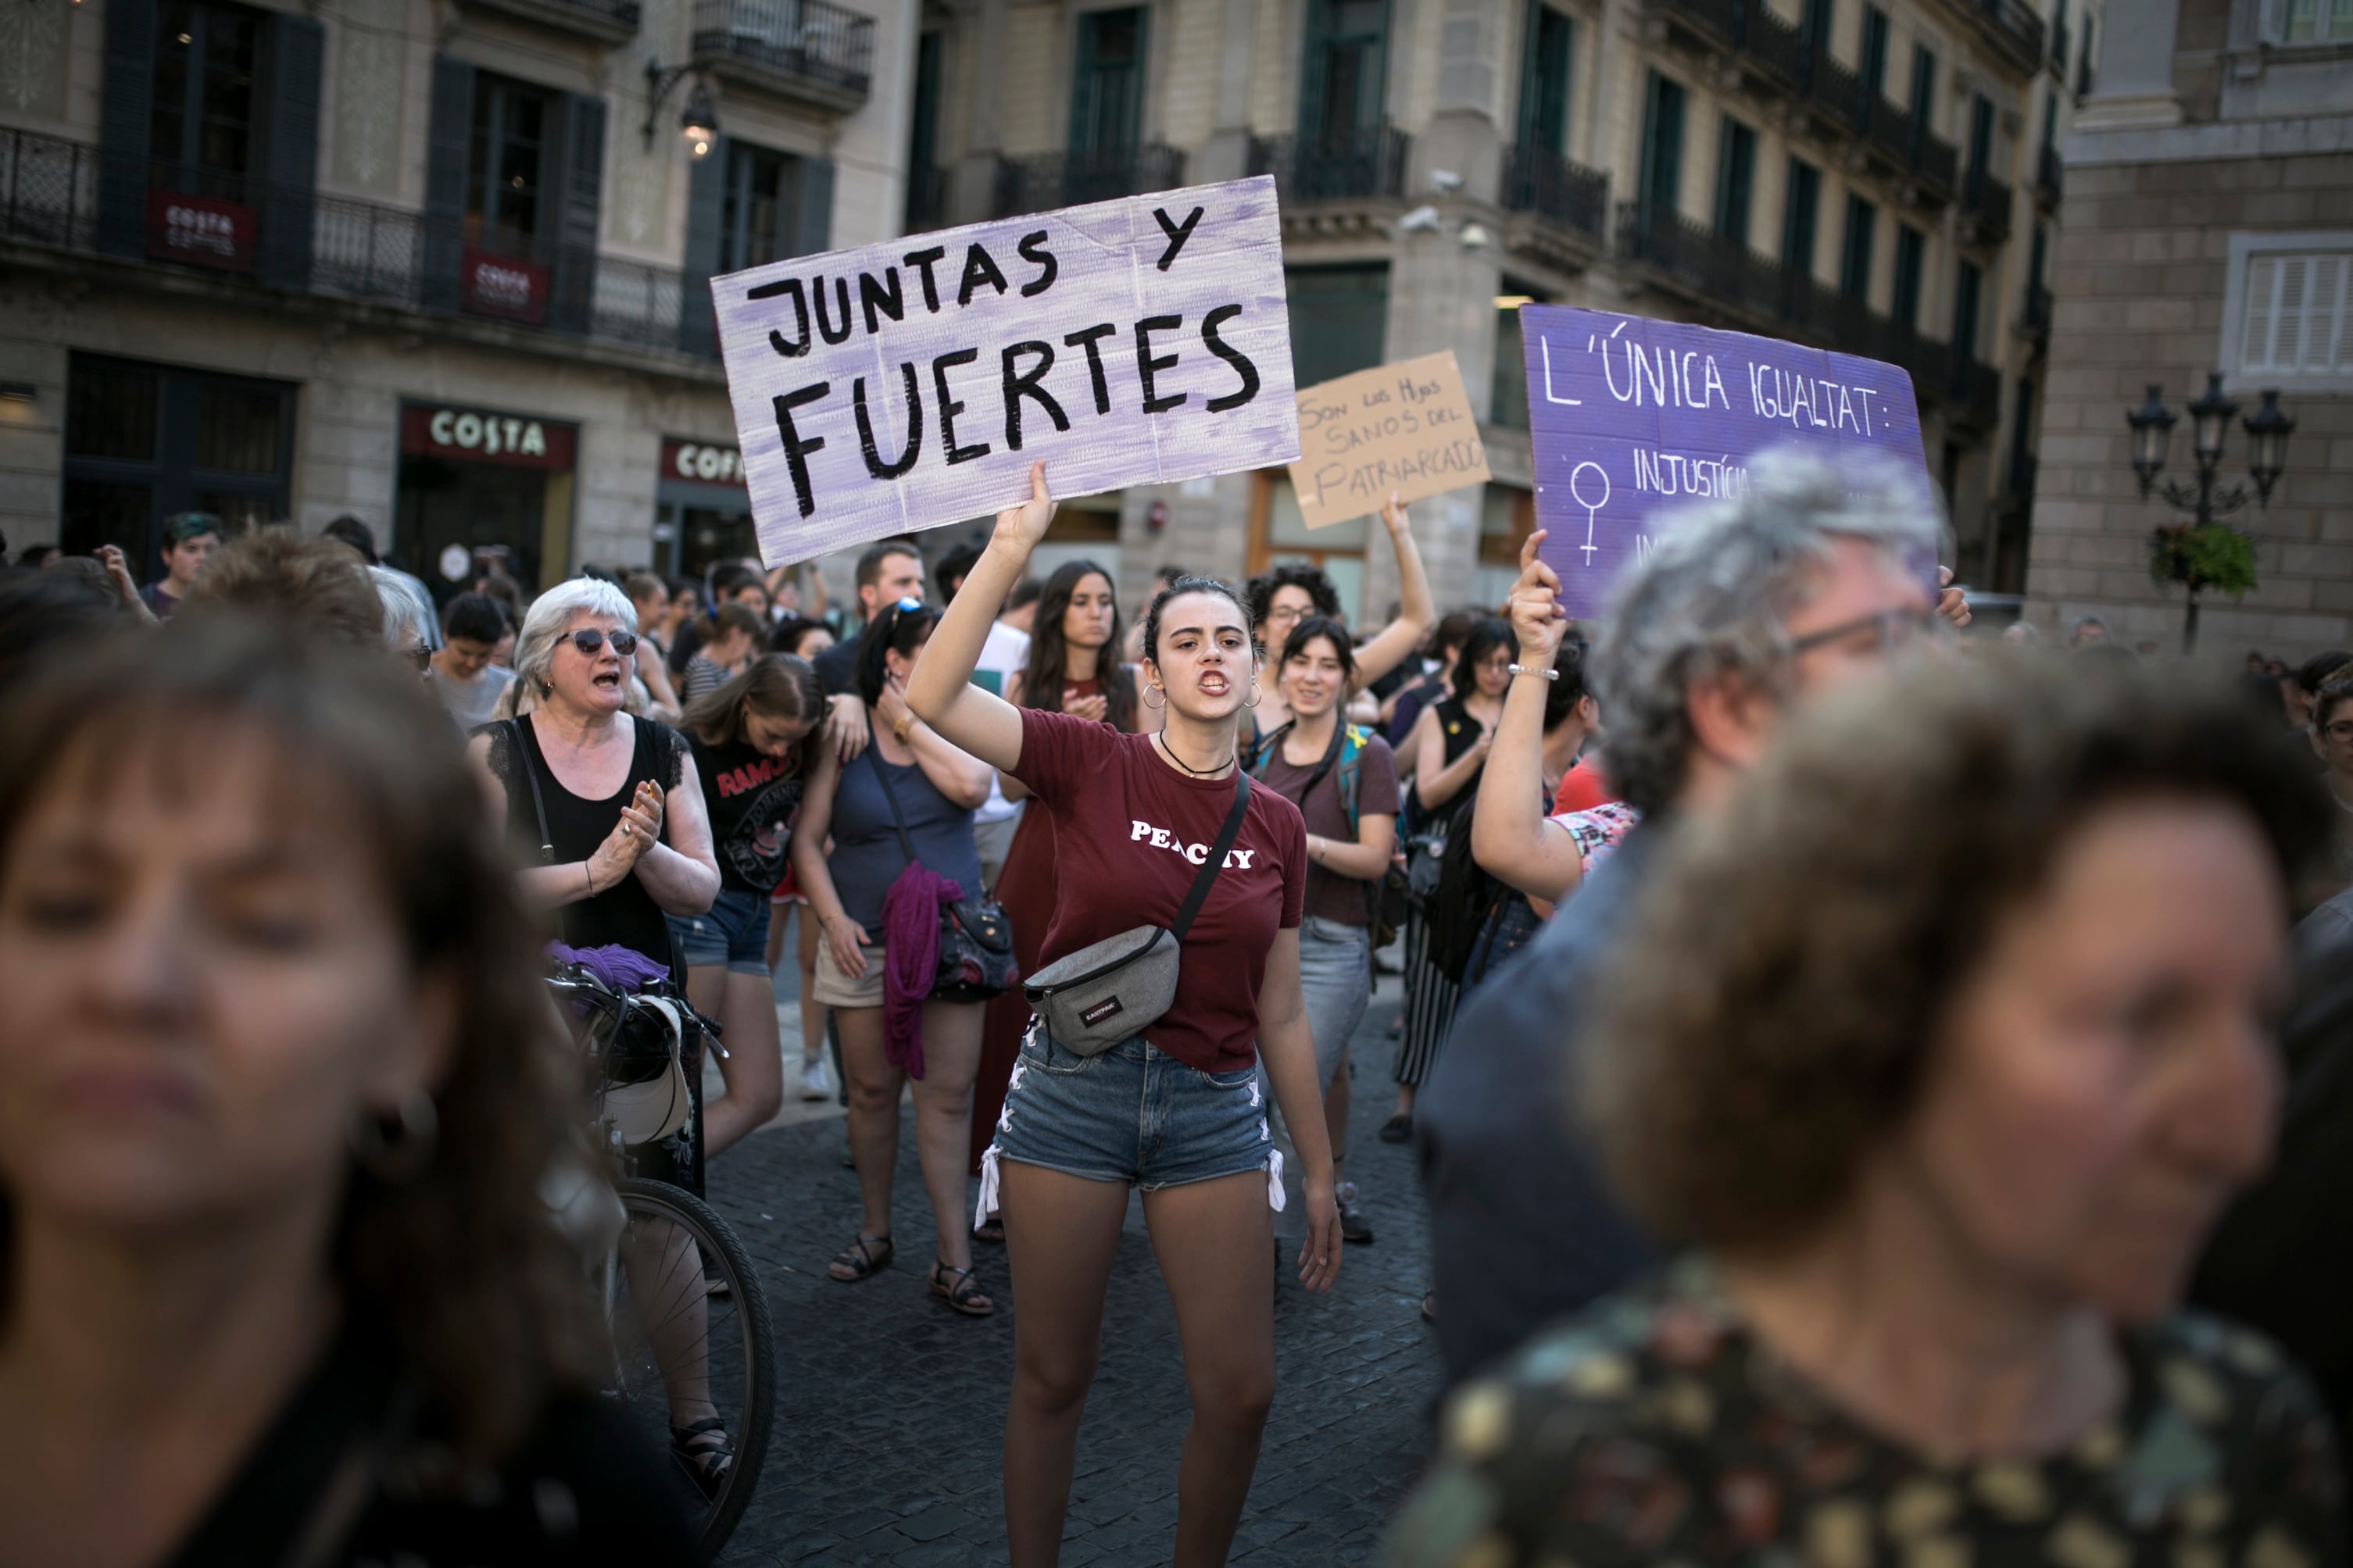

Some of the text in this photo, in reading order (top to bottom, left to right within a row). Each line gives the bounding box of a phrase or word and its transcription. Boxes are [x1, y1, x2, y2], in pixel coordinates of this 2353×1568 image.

[747, 205, 1204, 357] JUNTAS Y
[1541, 321, 1730, 410] L'ÚNICA
[430, 410, 546, 457] COSTA
[773, 304, 1260, 519] FUERTES
[1325, 407, 1463, 454] SANOS DEL
[1314, 438, 1484, 506] PATRIARCADO
